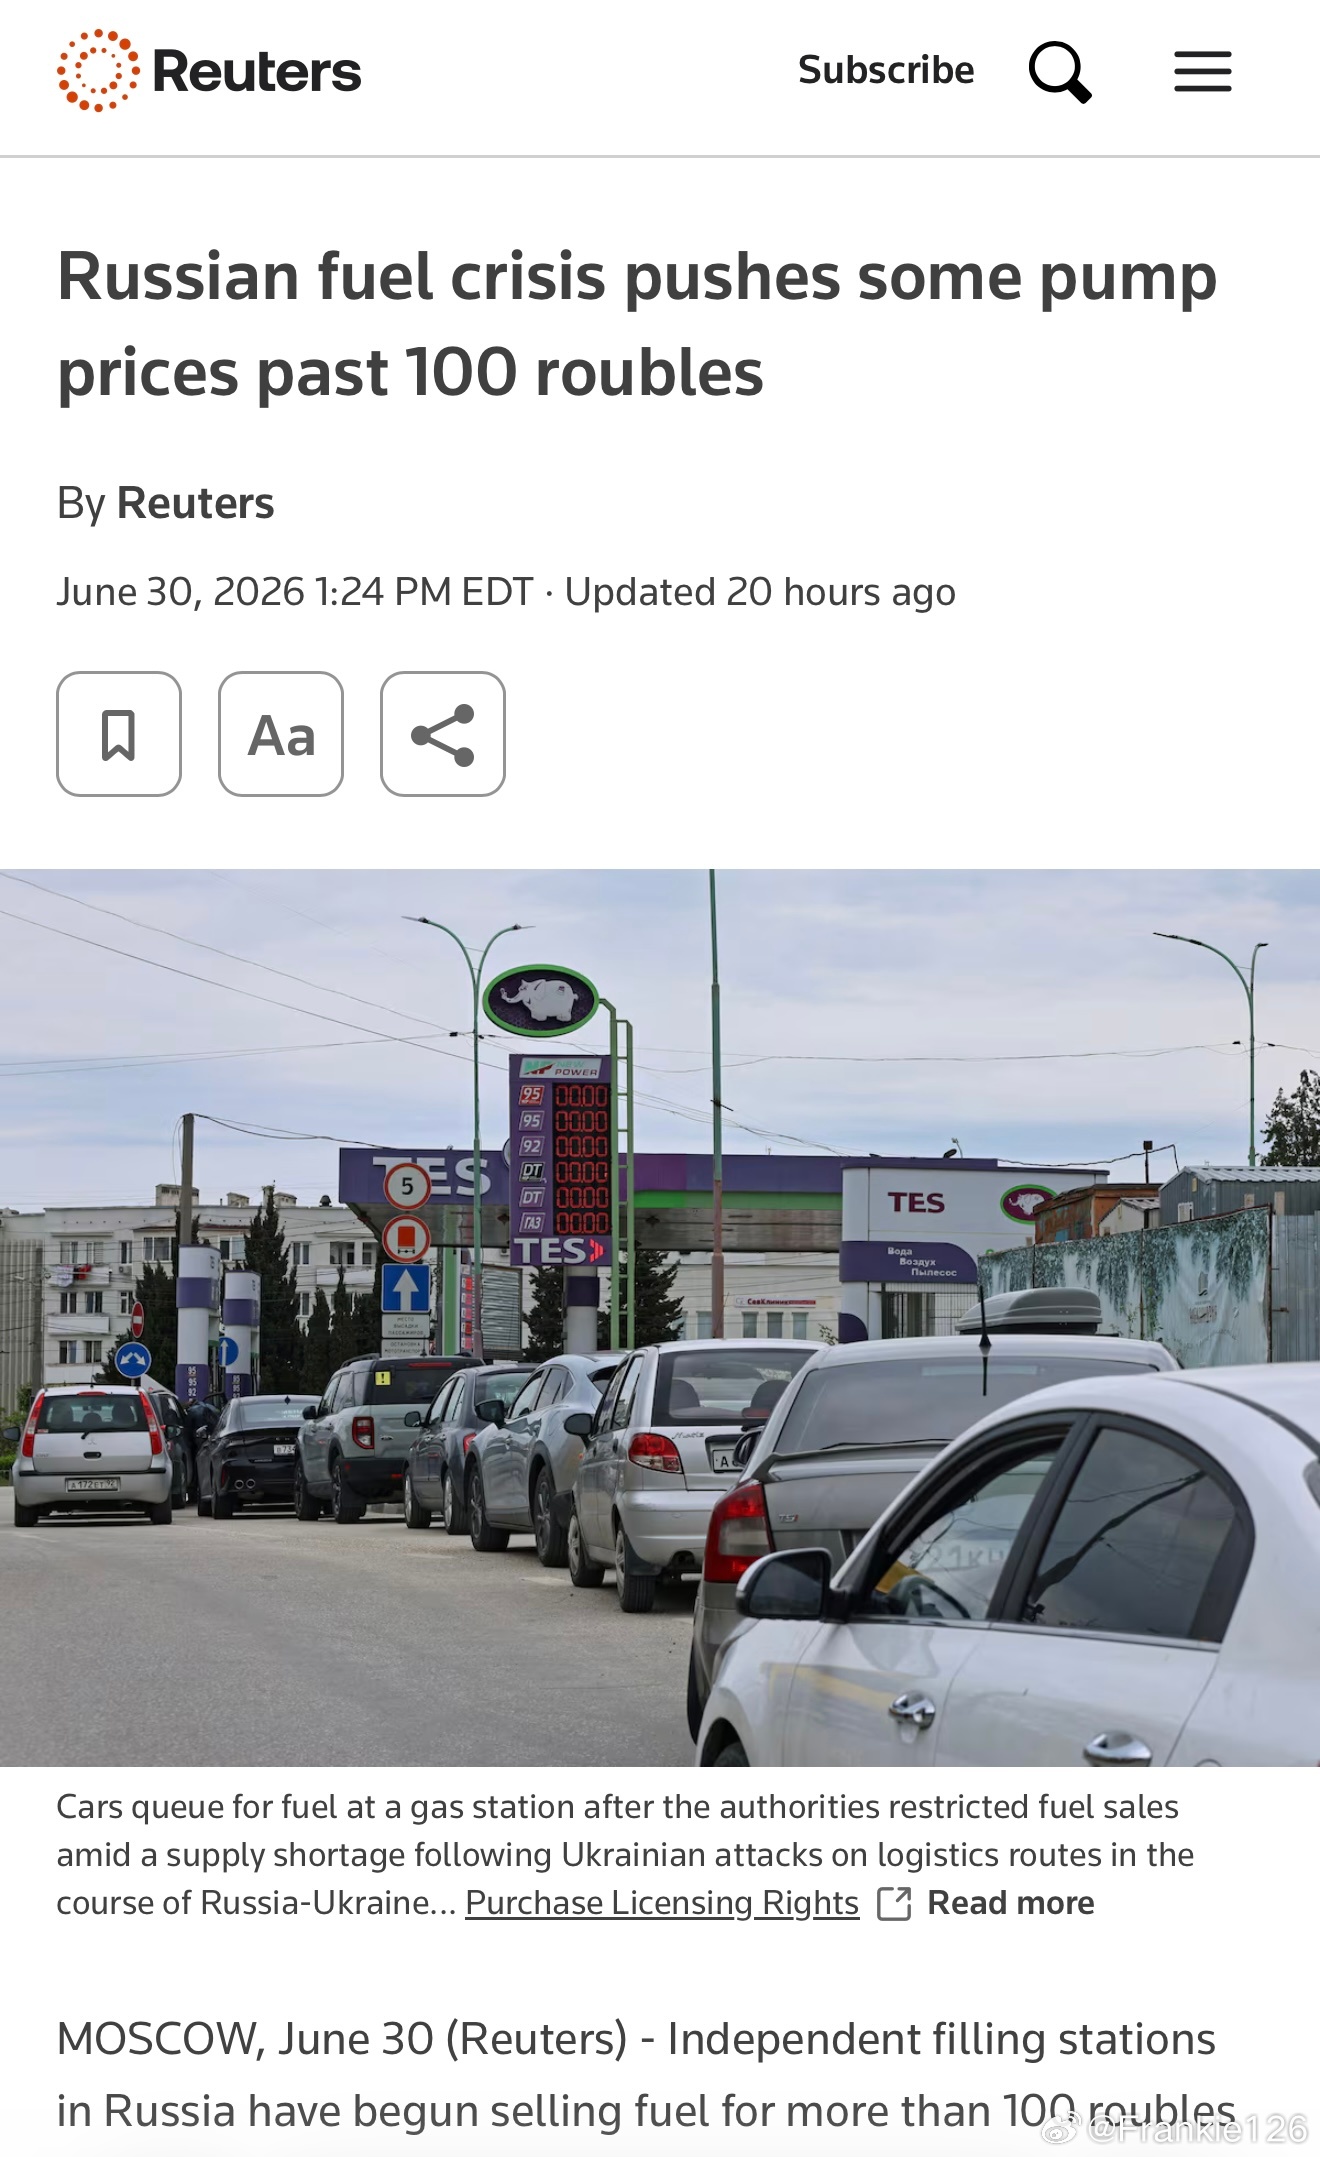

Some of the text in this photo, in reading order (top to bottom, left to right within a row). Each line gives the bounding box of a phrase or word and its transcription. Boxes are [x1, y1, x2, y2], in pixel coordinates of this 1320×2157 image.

[555, 1068, 598, 1076] POWER
[524, 1087, 541, 1099] 95
[523, 1115, 540, 1127] 95
[523, 1140, 541, 1152] 92
[402, 1177, 414, 1195] 5
[887, 1192, 945, 1213] TES
[524, 1216, 541, 1229] ГАЗ
[514, 1237, 586, 1264] TES
[887, 1247, 913, 1256] Вода
[900, 1257, 936, 1267] Воздух
[911, 1268, 957, 1276] Пылесос
[188, 1378, 197, 1386] 95
[188, 1388, 196, 1397] 92
